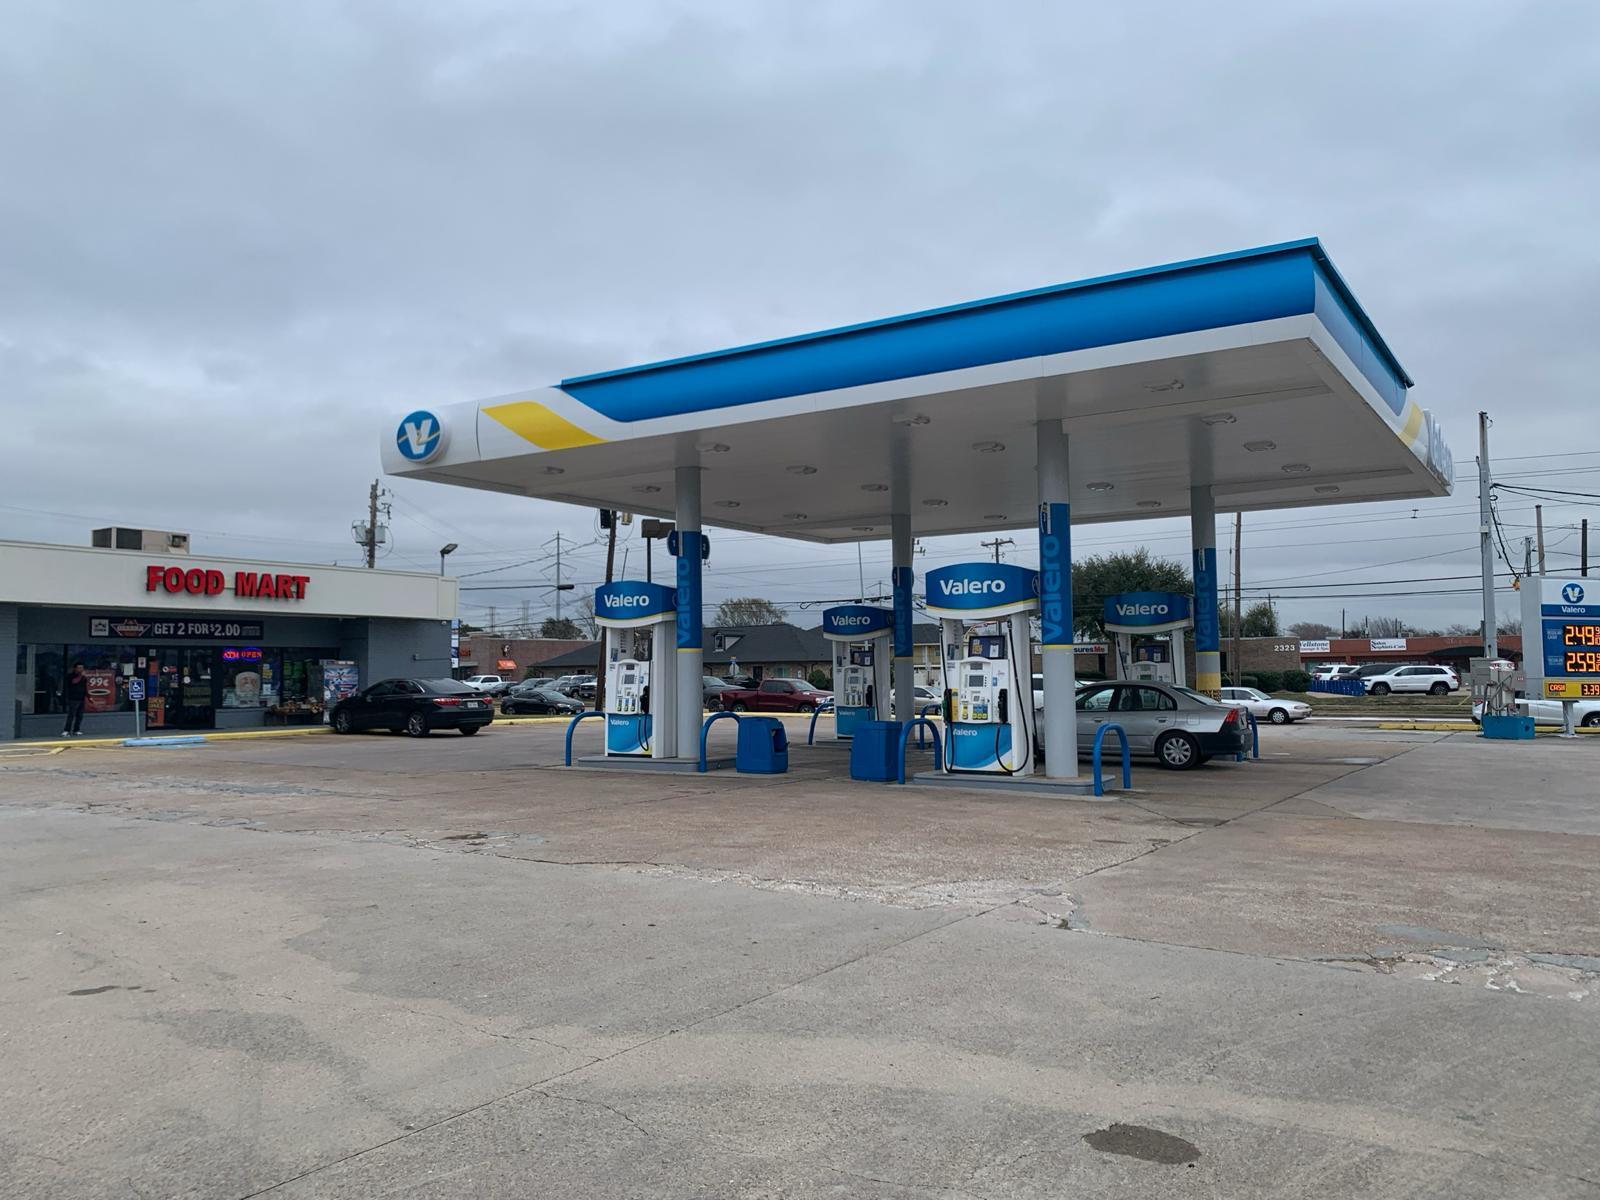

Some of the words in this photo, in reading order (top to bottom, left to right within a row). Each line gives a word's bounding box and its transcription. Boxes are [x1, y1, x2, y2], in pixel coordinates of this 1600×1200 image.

[146, 566, 225, 595] FOOD
[235, 571, 311, 600] MART
[940, 578, 1006, 596] Valero
[1043, 535, 1063, 642] Valero
[604, 594, 650, 608] Valero
[677, 558, 690, 646] Valero
[1116, 603, 1169, 616] Valero
[1561, 605, 1586, 614] Valero
[831, 615, 871, 626] Valero
[154, 622, 175, 635] GET
[177, 622, 185, 635] 2
[188, 623, 209, 635] FOR
[210, 623, 241, 637] $2.00
[1273, 644, 1296, 652] 2323
